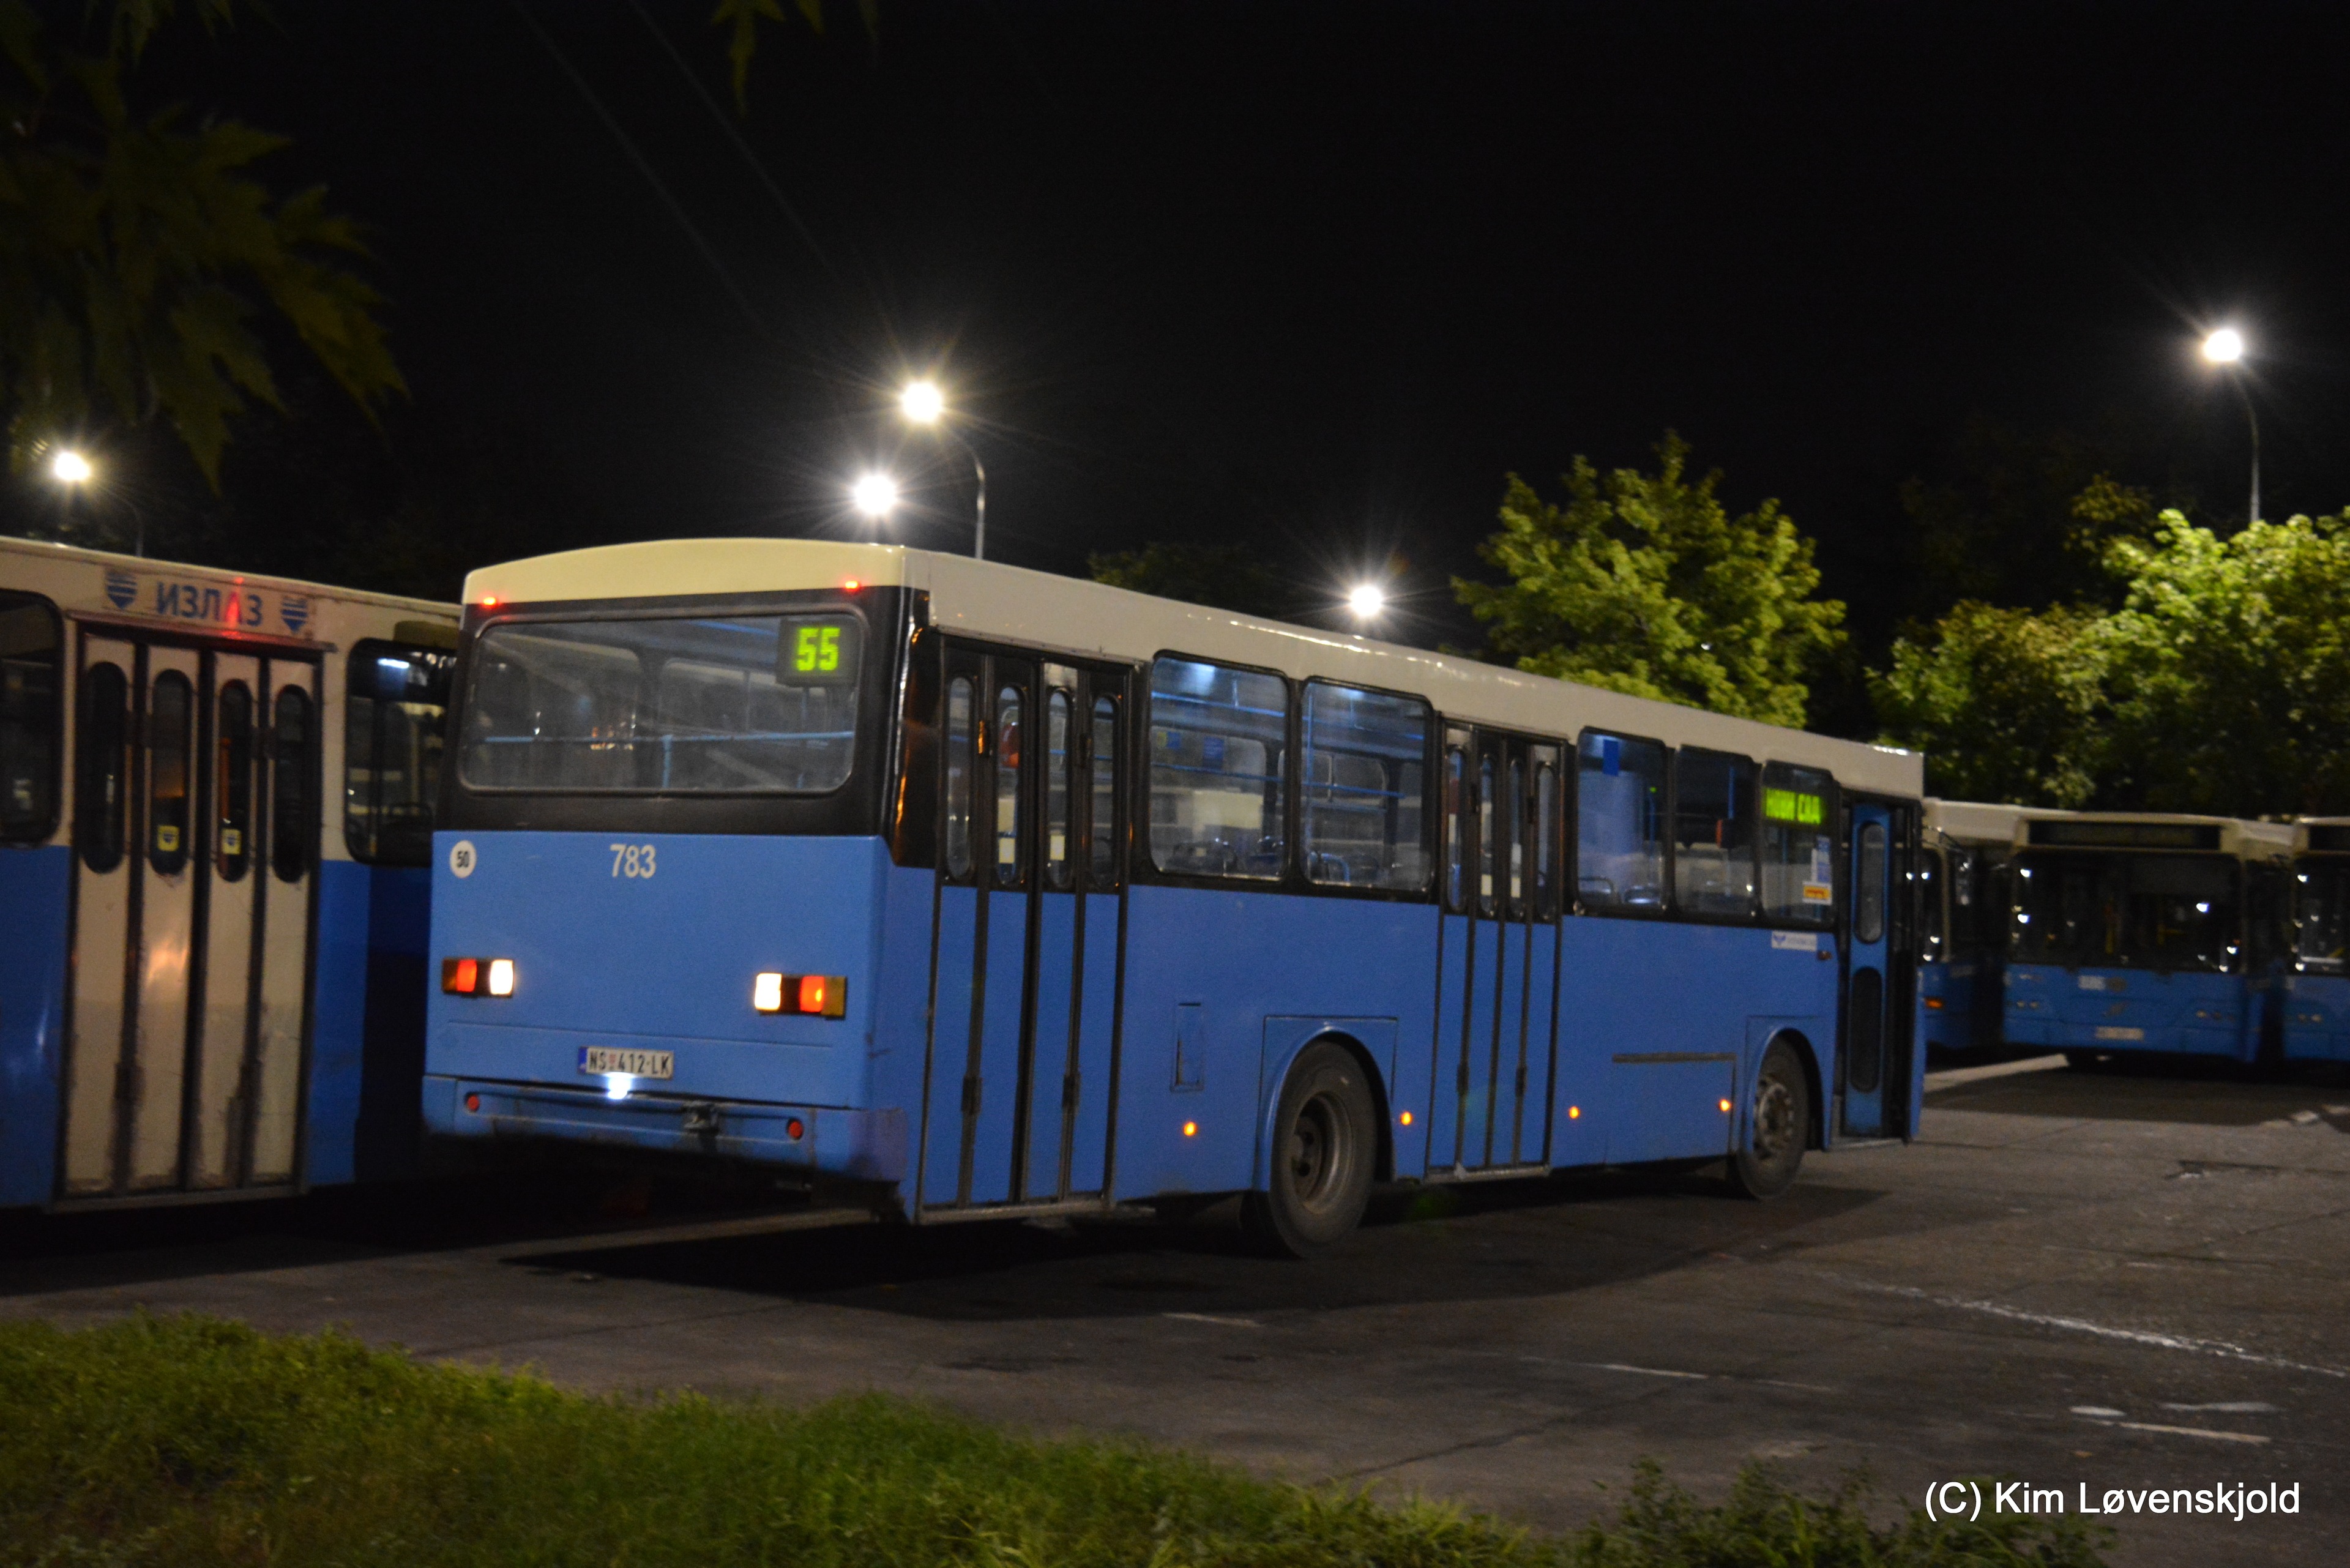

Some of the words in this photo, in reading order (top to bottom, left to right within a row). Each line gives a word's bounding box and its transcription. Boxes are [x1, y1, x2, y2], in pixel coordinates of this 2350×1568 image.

[156, 581, 263, 627] ИЗЛАЗ
[796, 627, 841, 671] 55
[456, 850, 470, 868] 50
[610, 843, 657, 879] 783
